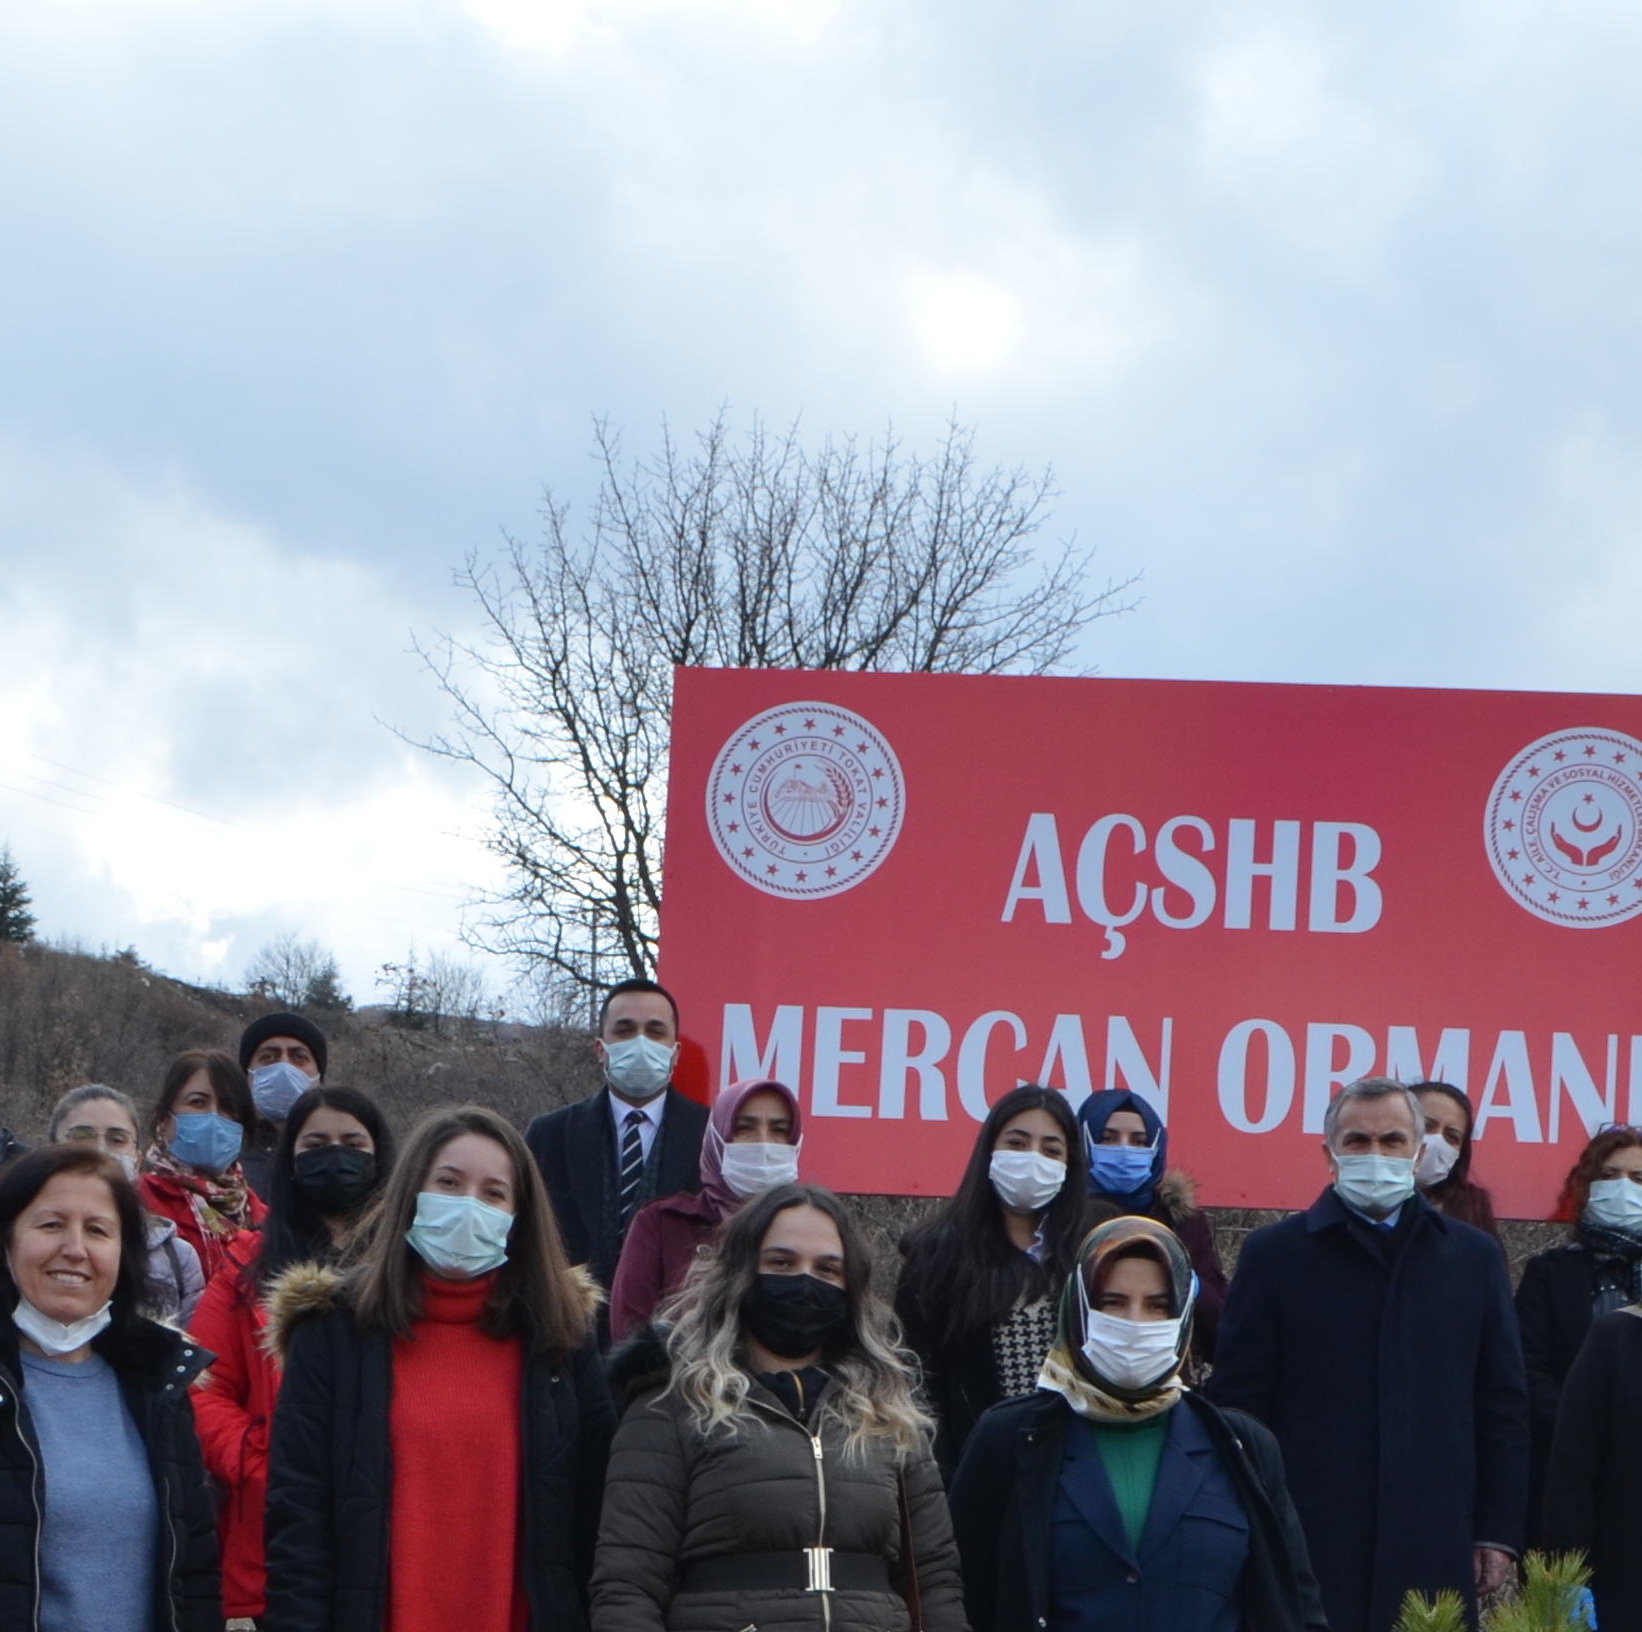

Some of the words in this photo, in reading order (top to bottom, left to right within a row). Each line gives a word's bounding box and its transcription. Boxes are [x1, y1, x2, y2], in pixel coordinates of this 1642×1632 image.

[838, 751, 868, 794] TOKAT
[1547, 776, 1561, 789] VE
[1562, 767, 1605, 781] SOSYAL
[1000, 812, 1383, 960] AÇSHB
[718, 1002, 1173, 1128] MERCAN
